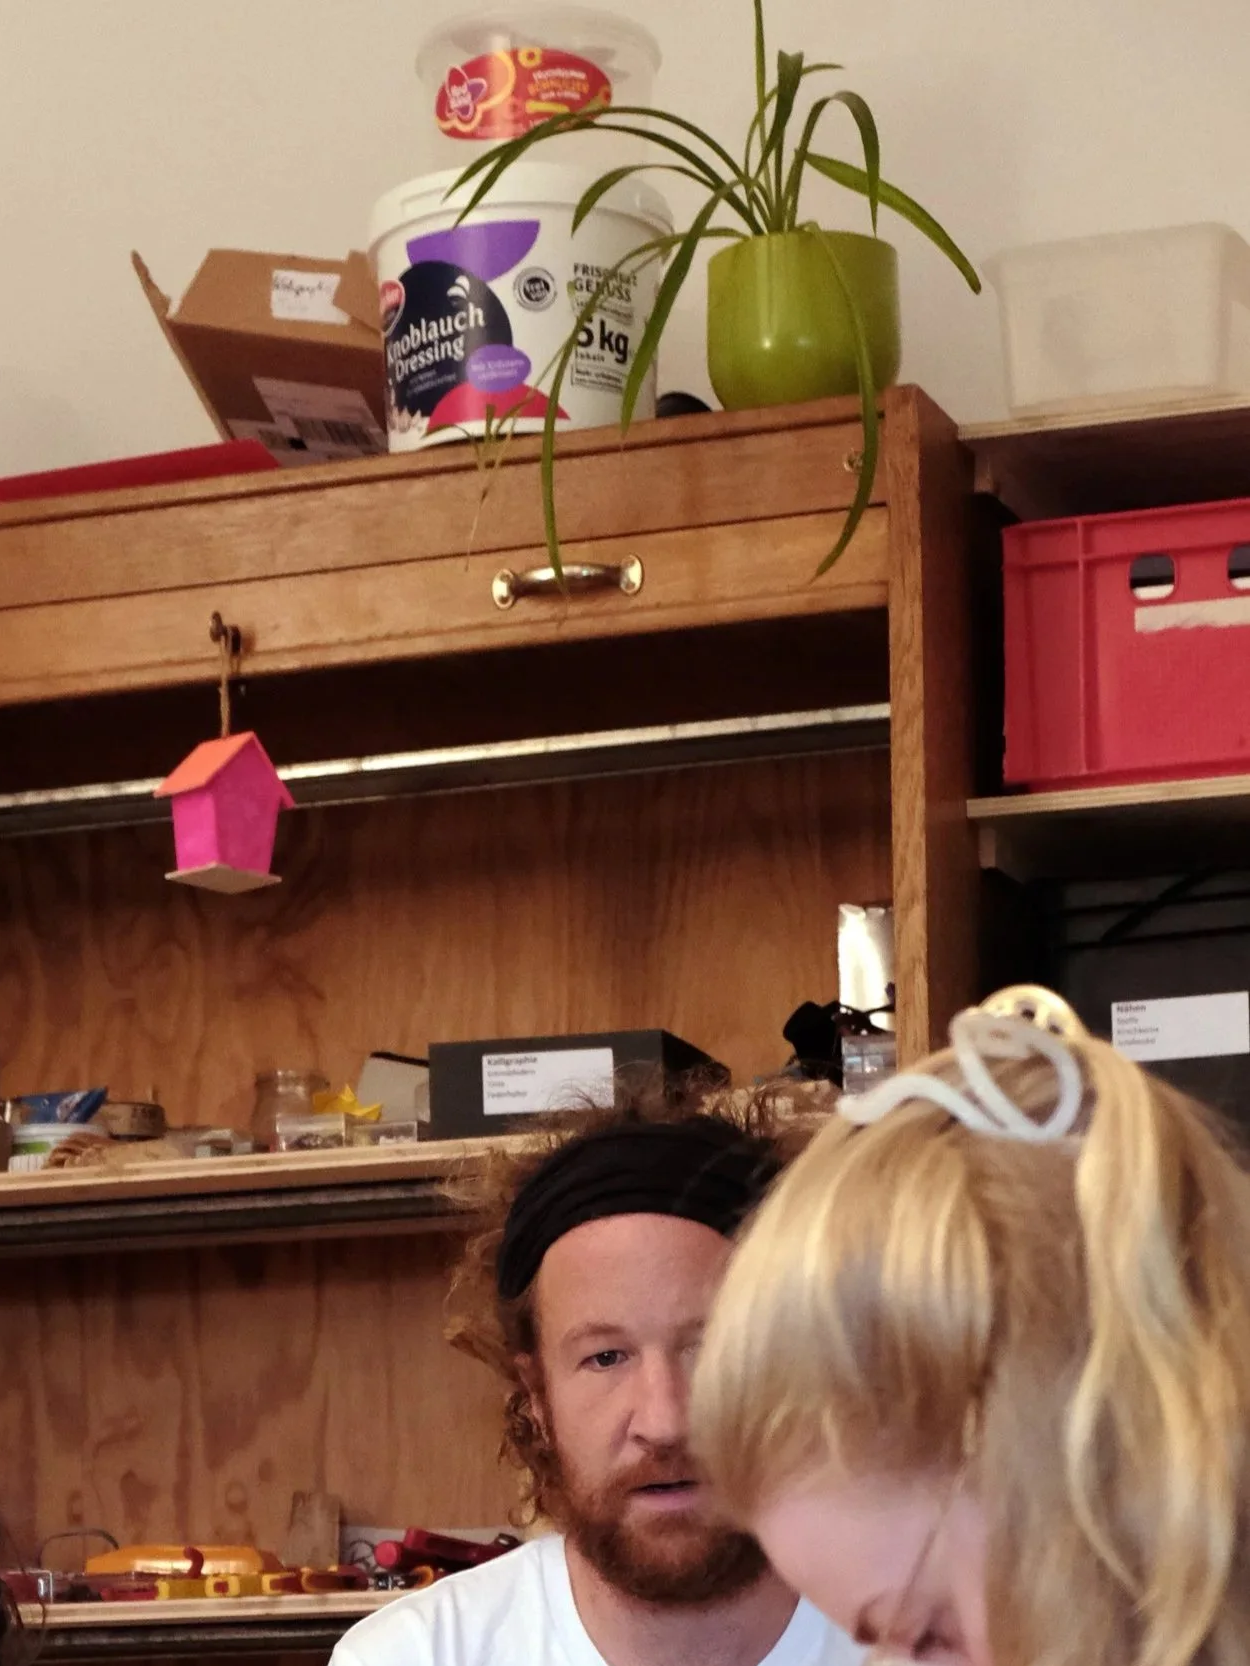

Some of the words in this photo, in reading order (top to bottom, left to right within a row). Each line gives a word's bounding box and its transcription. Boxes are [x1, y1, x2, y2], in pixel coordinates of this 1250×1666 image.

[395, 333, 465, 384] Dressing
[574, 315, 594, 348] 5
[599, 318, 630, 366] kg
